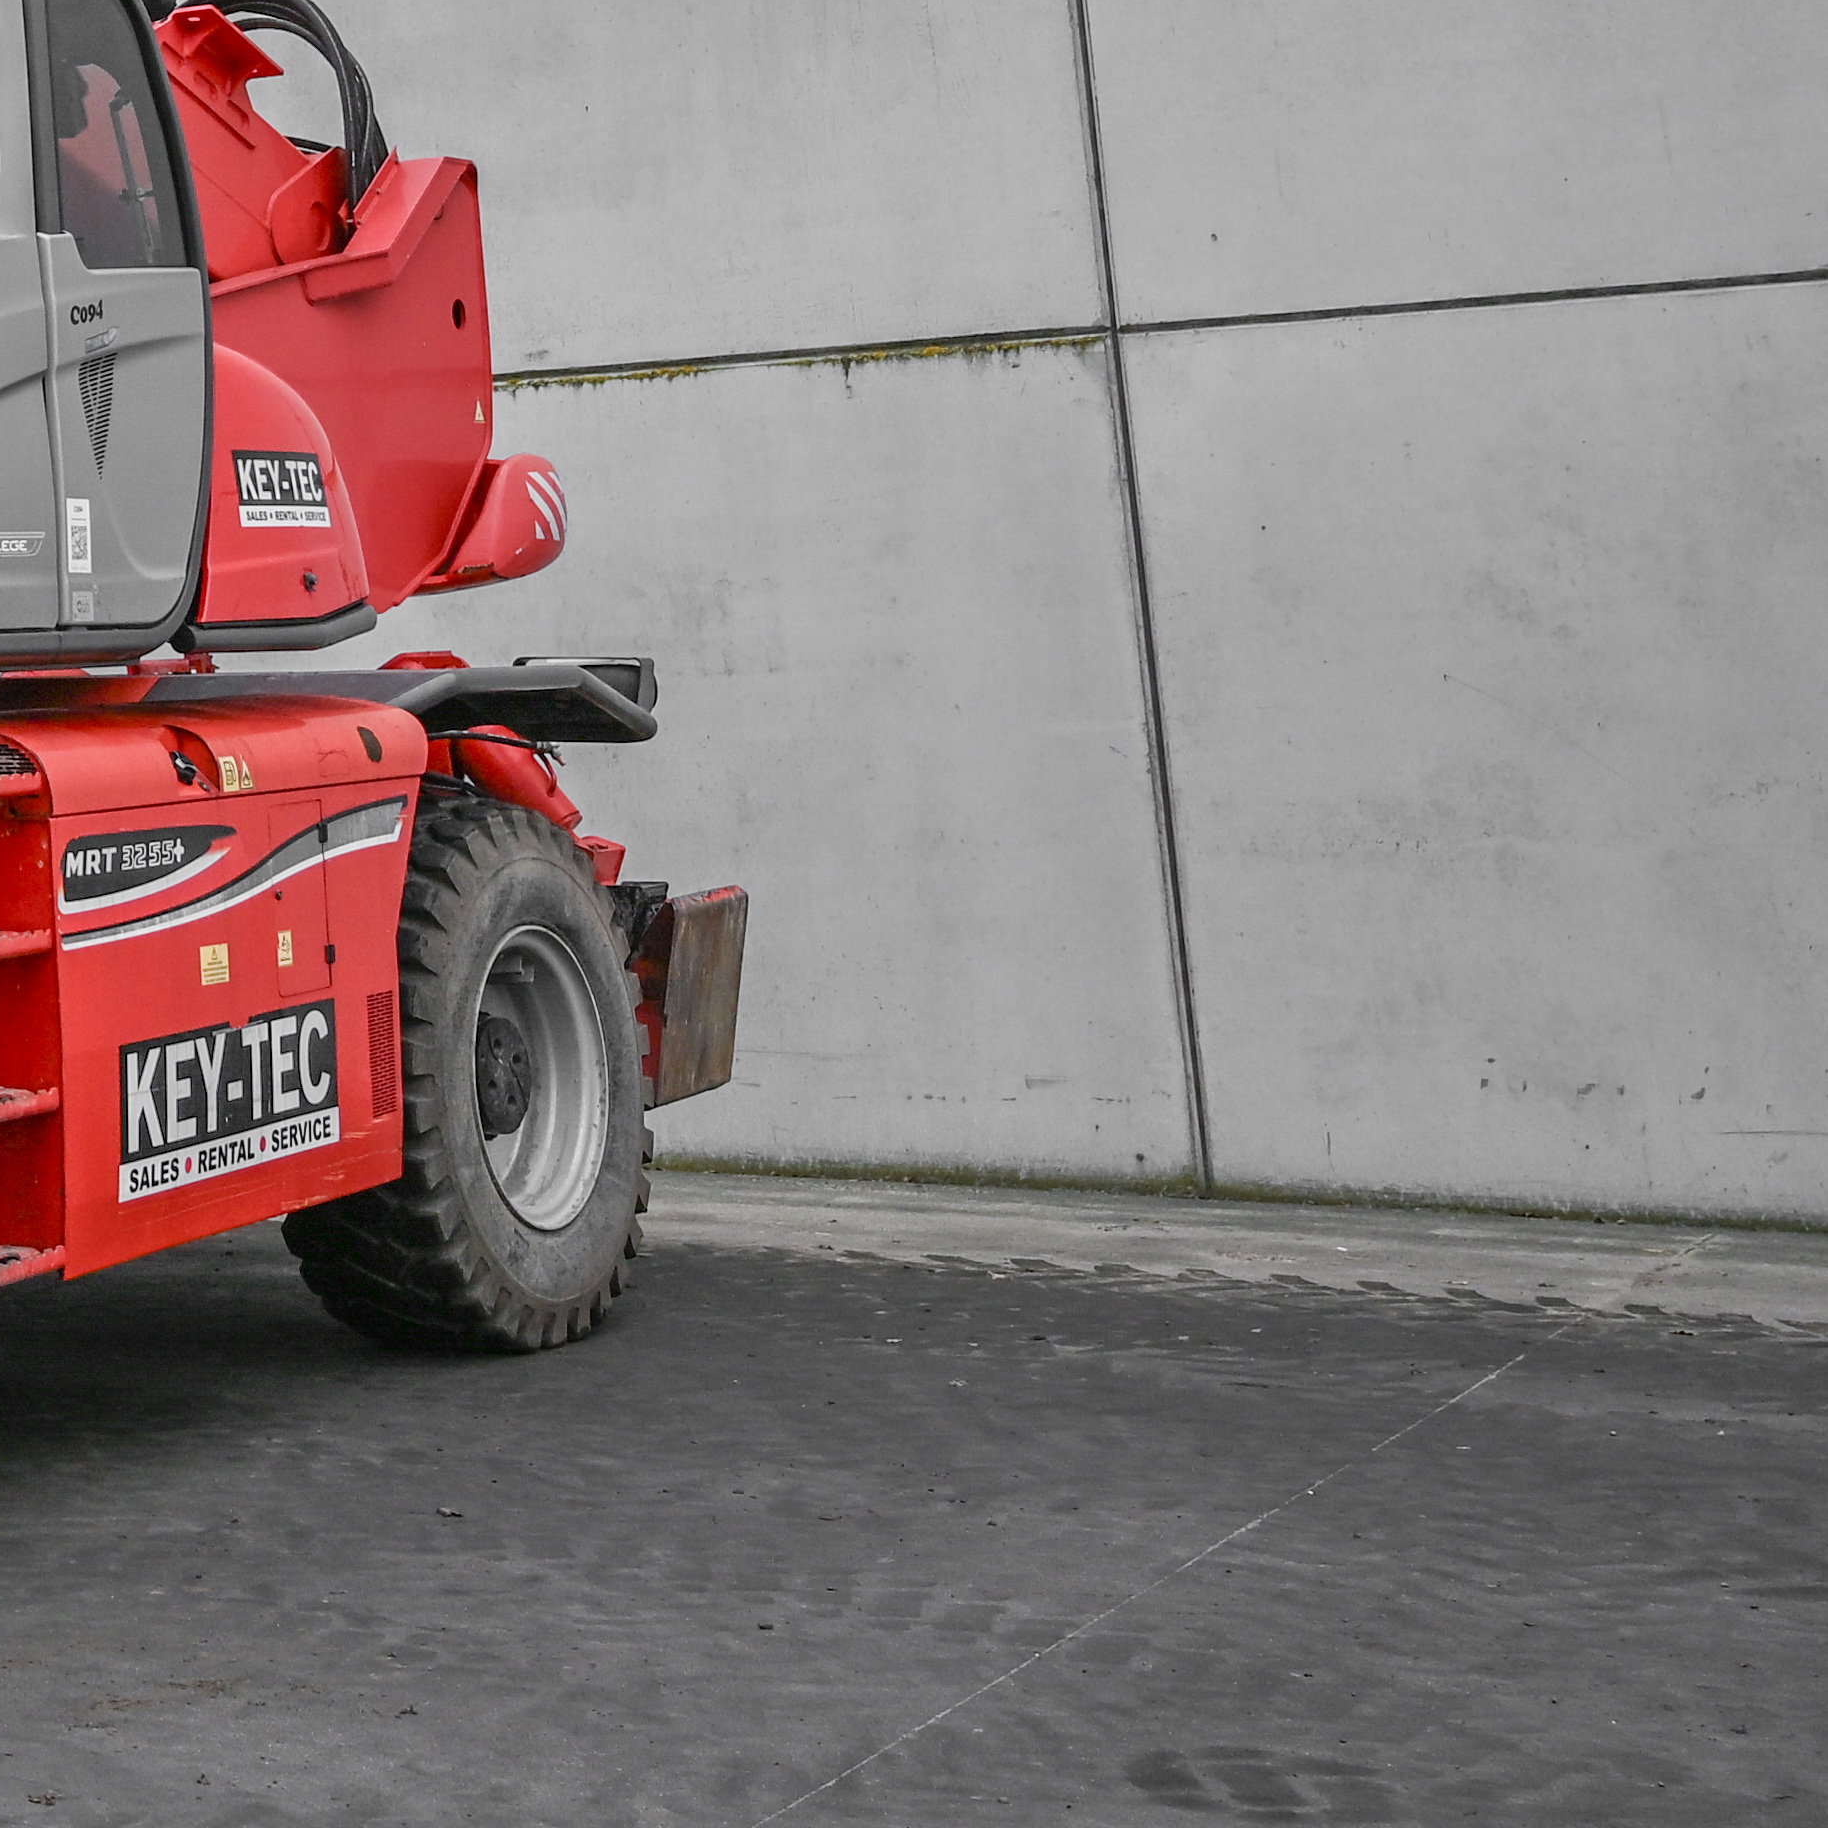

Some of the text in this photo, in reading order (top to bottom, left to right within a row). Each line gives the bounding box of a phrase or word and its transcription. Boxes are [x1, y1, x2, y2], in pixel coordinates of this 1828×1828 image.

[70, 299, 103, 325] C094
[237, 458, 323, 502] KEY-TEC
[246, 510, 327, 522] SALES RENTAL SERVICE
[65, 846, 118, 879] MRT
[126, 1009, 331, 1154] KEY-TEC
[129, 1115, 332, 1193] SALES RENTAL SERVICE
